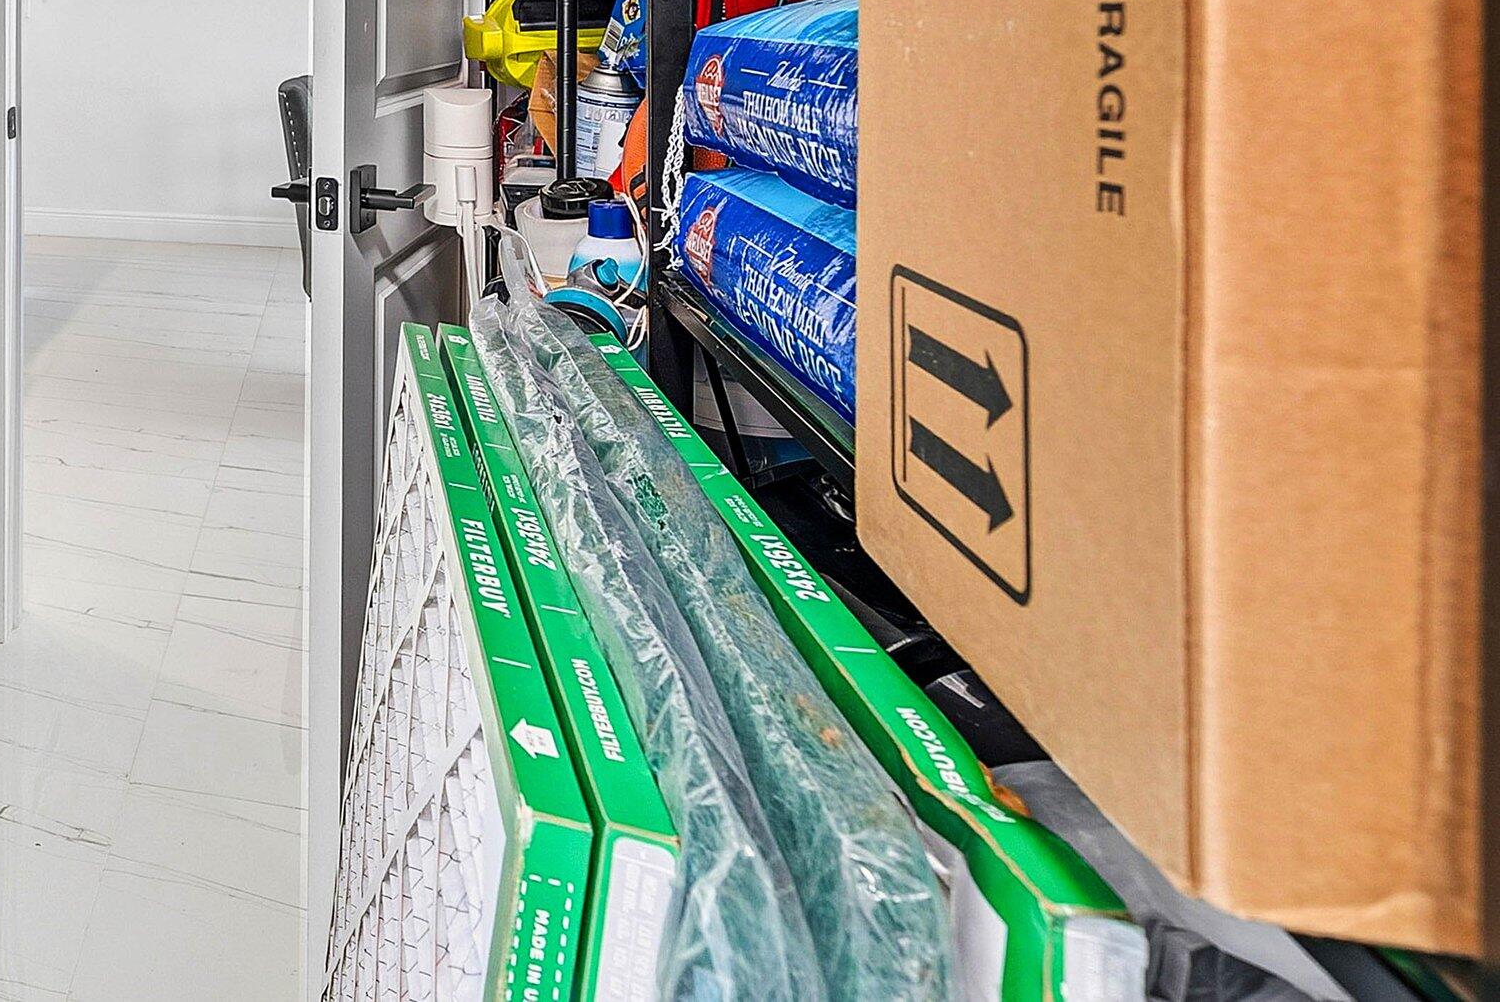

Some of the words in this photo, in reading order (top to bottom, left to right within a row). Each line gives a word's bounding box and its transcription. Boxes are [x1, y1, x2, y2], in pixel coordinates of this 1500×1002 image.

[743, 264, 768, 303] THAI
[797, 300, 830, 348] MALI
[464, 373, 498, 424] FILTERBUY
[632, 384, 692, 439] FILTERBUY
[460, 518, 512, 619] FILTERBUY
[570, 657, 626, 764] FILTERBUY.COM
[529, 909, 551, 962] MADE
[522, 987, 540, 1002] U
[525, 963, 544, 986] IN
